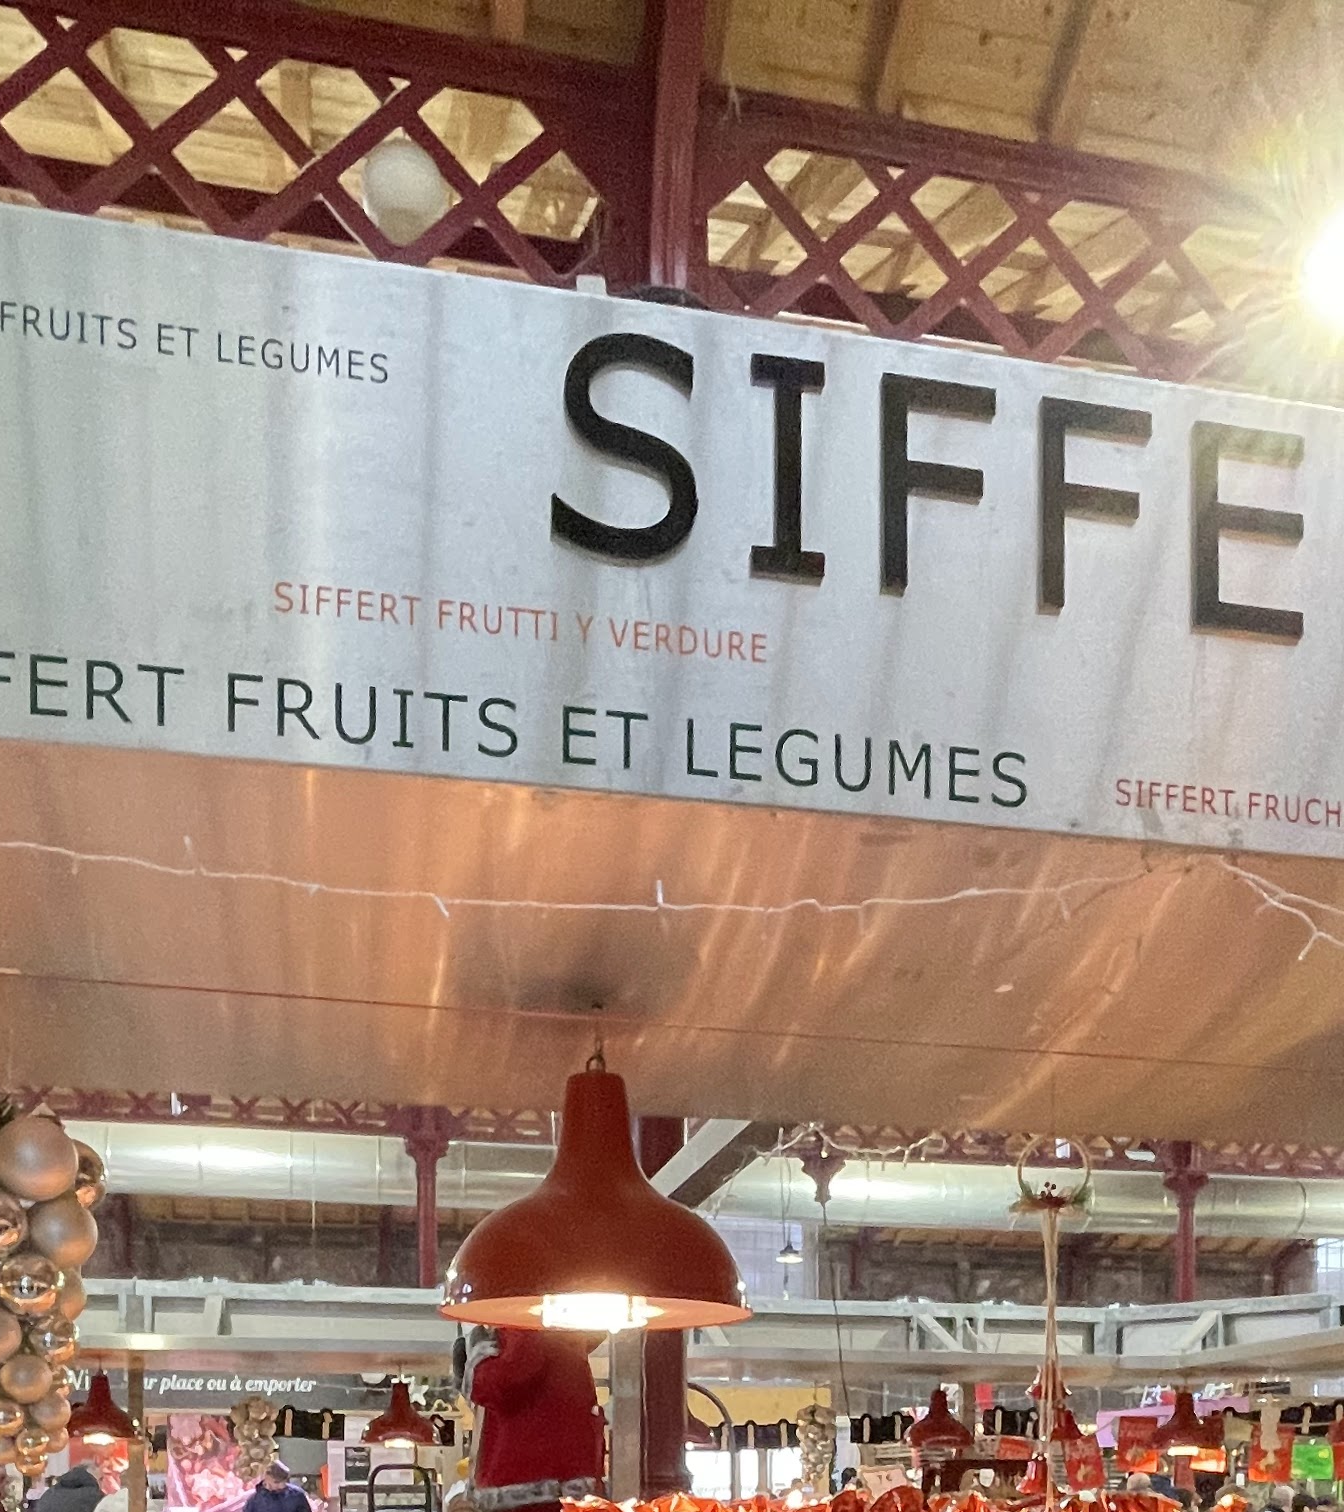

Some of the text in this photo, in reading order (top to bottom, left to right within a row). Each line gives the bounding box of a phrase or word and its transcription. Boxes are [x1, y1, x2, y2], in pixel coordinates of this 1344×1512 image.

[0, 301, 138, 351] FRUITS
[157, 325, 199, 359] ET
[217, 331, 390, 385] LEGUMES
[275, 581, 768, 664] SIFFERT FRUTTI Y VERDURE
[226, 672, 520, 760] FRUITS
[561, 705, 649, 771] ET
[687, 717, 1030, 809] LEGUMES
[1114, 778, 1236, 818] SIFFERT
[159, 1374, 204, 1395] place
[206, 1376, 228, 1391] ou
[244, 1373, 317, 1397] emporter
